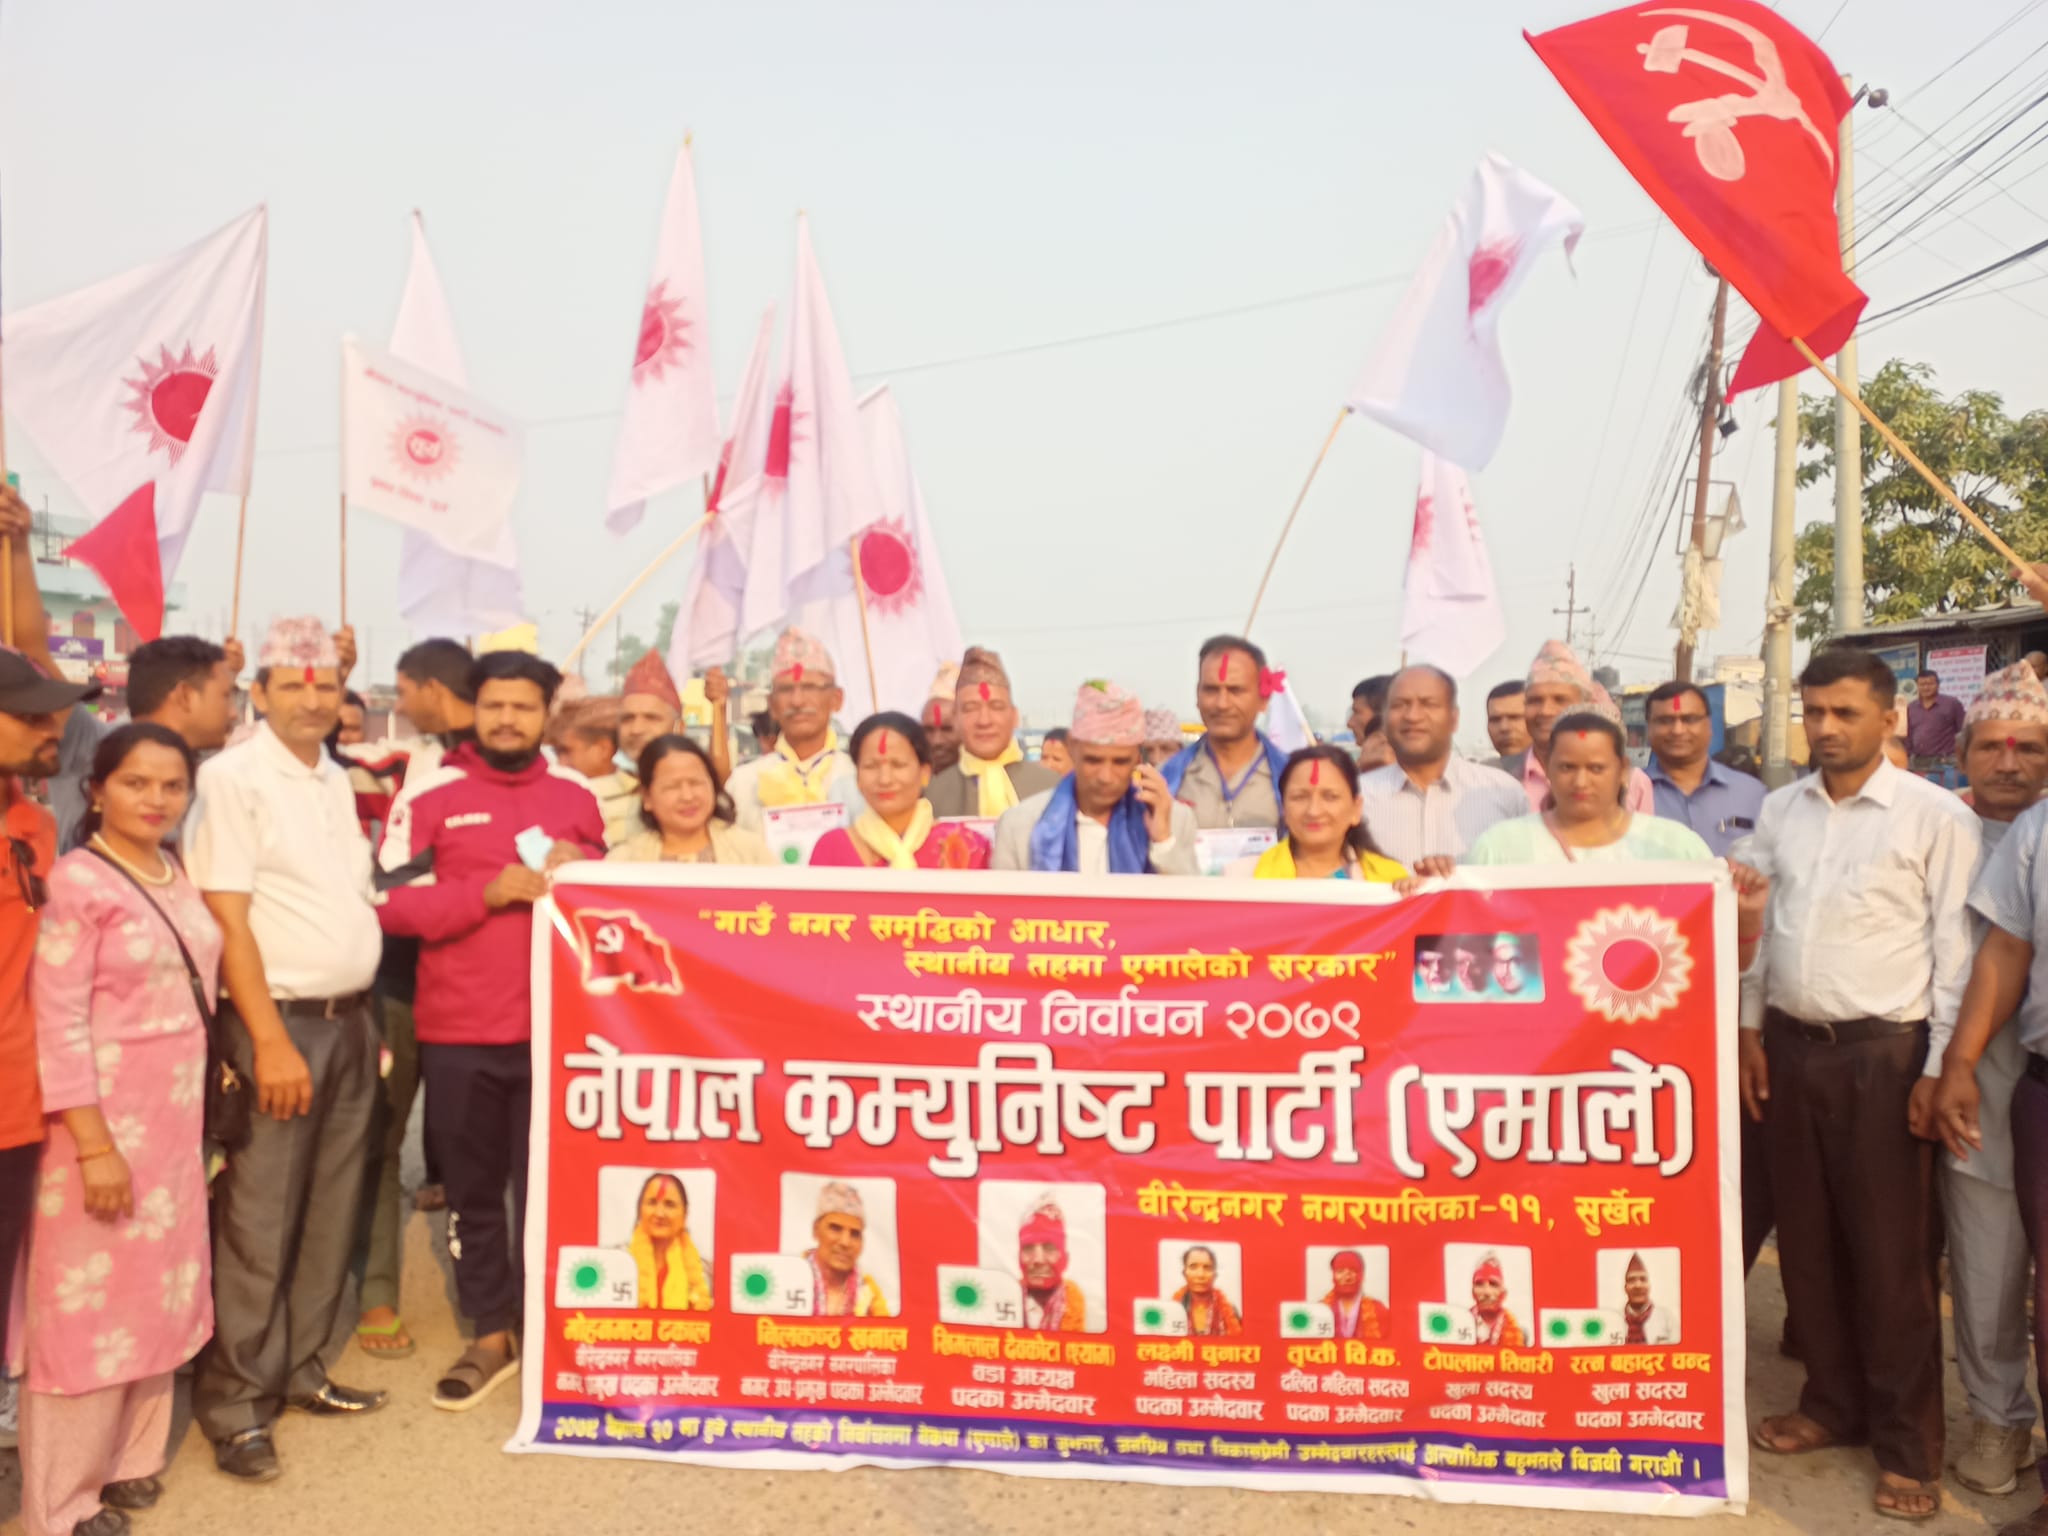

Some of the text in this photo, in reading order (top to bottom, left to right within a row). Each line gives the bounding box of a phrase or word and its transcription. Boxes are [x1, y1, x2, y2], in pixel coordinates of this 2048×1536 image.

[789, 913, 856, 940] नगर
[869, 908, 993, 948] समृद्धिको
[1010, 919, 1116, 949] आधार,
[904, 946, 1014, 977] स्थानीय
[1027, 954, 1107, 978] तहमा
[1120, 948, 1252, 983] एमालेको
[856, 985, 1360, 1039] स्थानीय निर्वाचन २०७९
[565, 1034, 1692, 1177] नेपाल कम्युनिष्ट पार्टी (एमाले)
[1137, 1179, 1288, 1226] वीरेन्द्रनगर
[1574, 1188, 1654, 1236] सुर्खेत
[972, 1364, 1005, 1383] वडा
[1571, 1353, 1710, 1375] रत्न बहादुर चन्द
[1144, 1365, 1255, 1390] महिला सदस्य
[1321, 1370, 1364, 1395] महिला
[1368, 1379, 1409, 1397] सदस्य
[1485, 1381, 1533, 1399] सदस्य
[952, 1388, 1096, 1416] पदका उम्मेदवार
[1592, 1382, 1687, 1404] खुला सदस्य
[1136, 1394, 1264, 1420] पदका उम्मेदवार
[1286, 1403, 1403, 1423] पदका उम्मेदवार
[1430, 1403, 1546, 1428] पदका उम्मेदवार
[1575, 1406, 1704, 1430] पदका उम्मेदवार
[1570, 1447, 1622, 1472] विजयी
